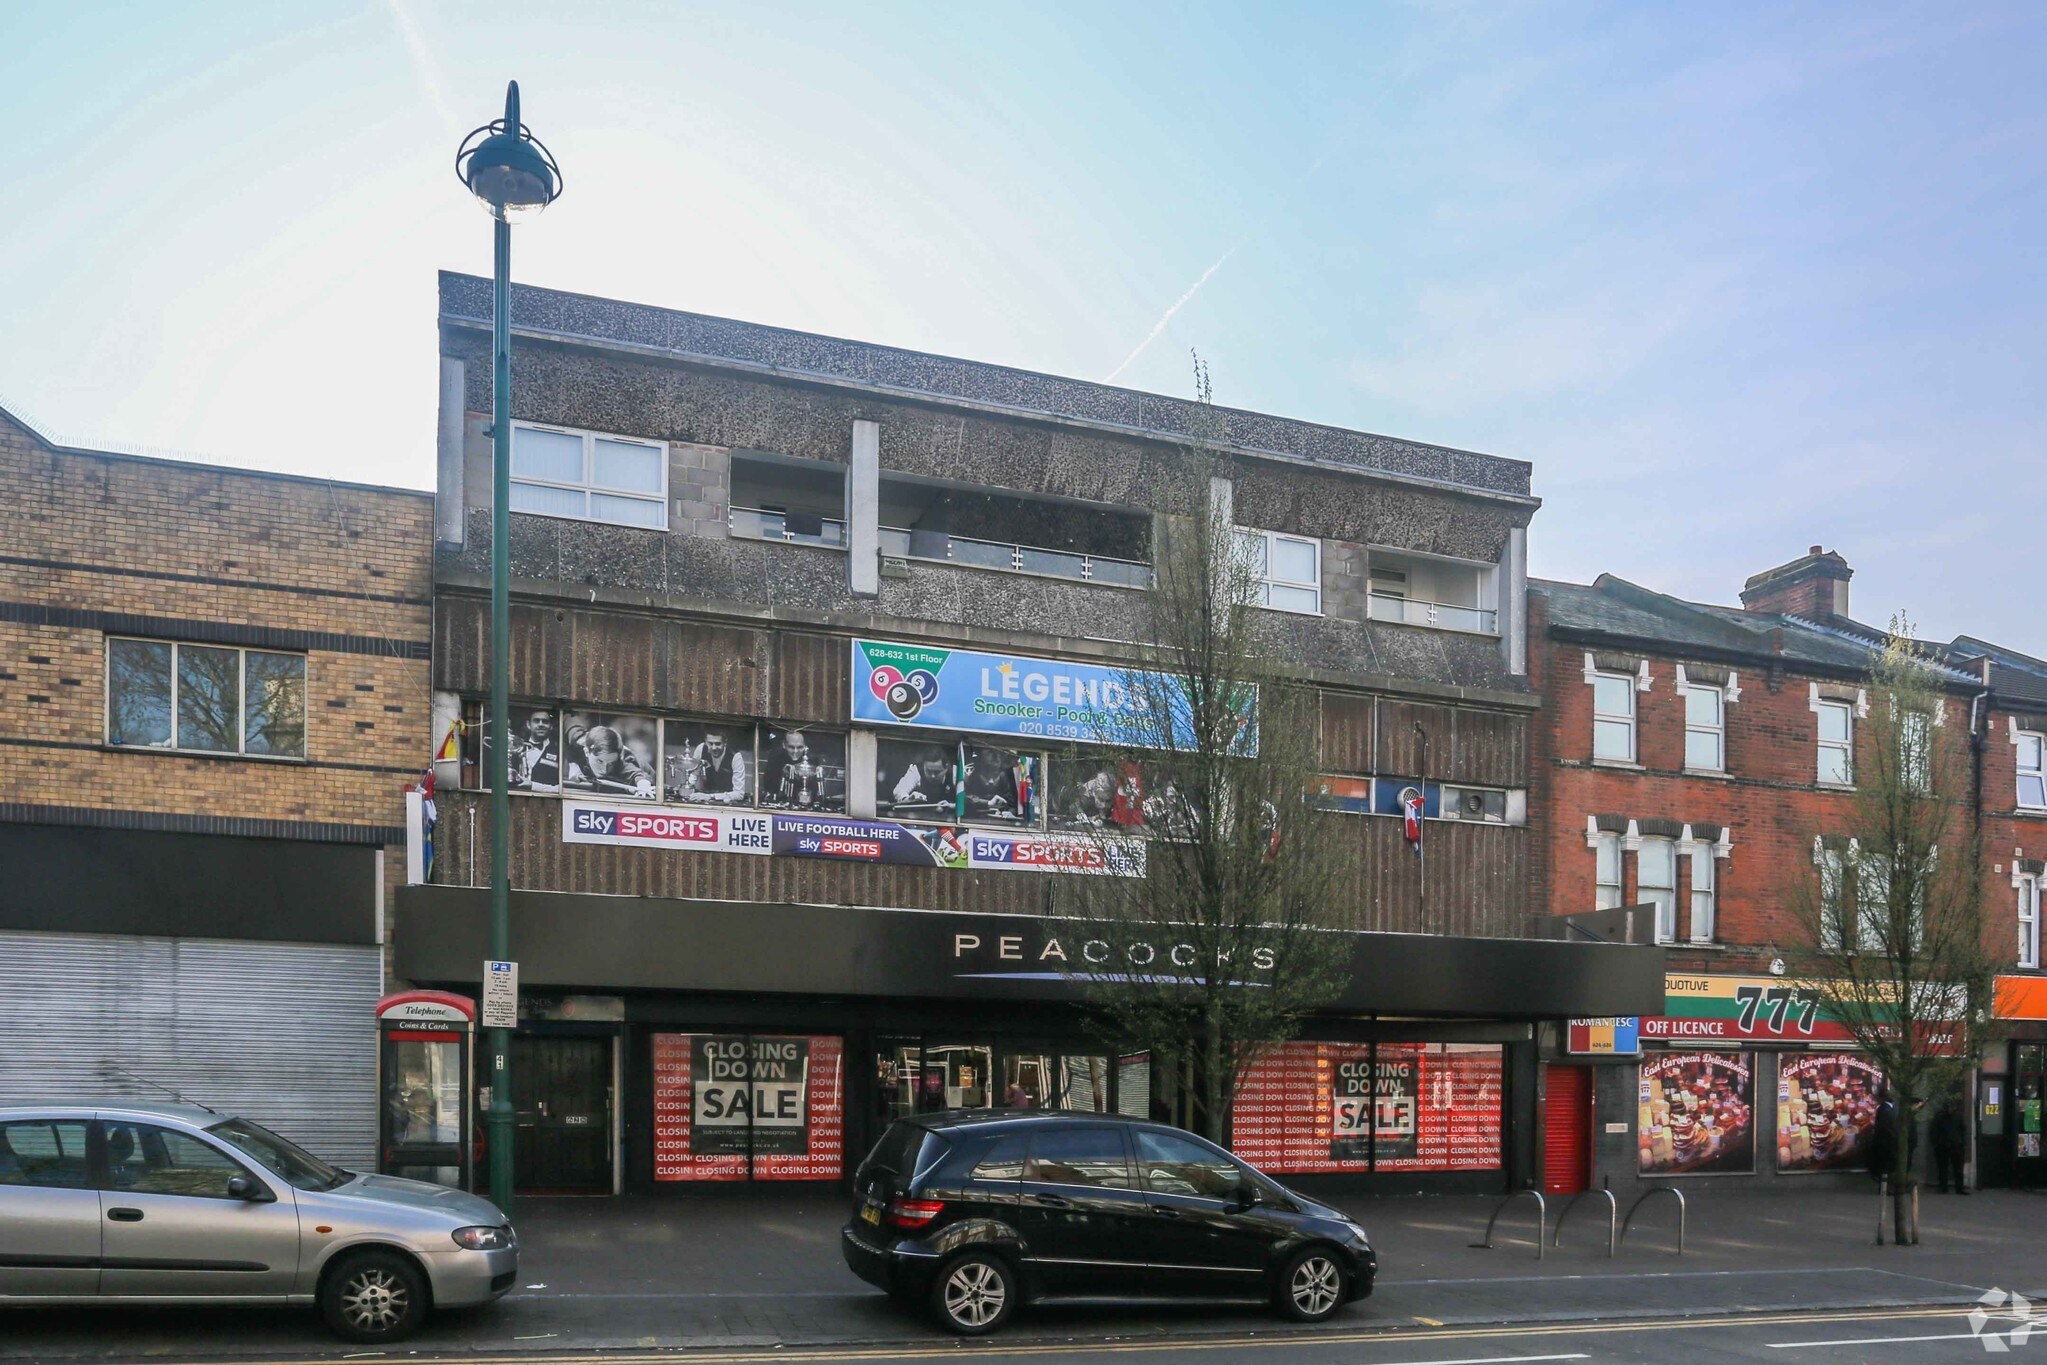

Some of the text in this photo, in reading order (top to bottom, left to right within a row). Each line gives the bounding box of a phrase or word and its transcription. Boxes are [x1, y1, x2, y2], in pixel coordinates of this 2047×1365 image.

[869, 648, 943, 664] 628-632 1st Floor
[896, 689, 904, 699] 7
[981, 667, 1150, 712] LEGENDS
[973, 698, 1043, 719] Snooker
[1056, 706, 1092, 725] Pool
[1098, 711, 1109, 726] &
[1019, 721, 1043, 735] 020
[1046, 724, 1078, 738] 8539
[577, 812, 715, 840] sky SPORTS
[731, 817, 767, 833] LIVE
[778, 820, 900, 840] LIVE FOOTBALL HERE
[728, 832, 770, 849] HERE
[798, 836, 879, 856] sky SPORTS
[976, 839, 1010, 863] sky
[1016, 842, 1103, 866] SPORTS
[955, 934, 1275, 970] PEACOCKS
[492, 963, 499, 971] P
[405, 1006, 447, 1016] Telephone
[1735, 984, 1821, 1035] 777
[399, 1021, 449, 1031] Coins & Cards
[1645, 1020, 1724, 1035] OFF LICENCE
[703, 1042, 797, 1060] CLOSING
[715, 1061, 786, 1078] DOWN
[1340, 1062, 1409, 1078] CLOSING
[1644, 1053, 1750, 1078] East European Delicatessen
[1783, 1055, 1883, 1078] East European Delicatessen
[812, 1078, 841, 1086] DOWN
[1347, 1079, 1401, 1094] DOWN
[656, 1089, 690, 1097] CLOSIN
[656, 1102, 690, 1110] CLOSIN
[703, 1088, 797, 1119] SALE
[1985, 1104, 1999, 1115] 622
[656, 1115, 690, 1123] CLOSIN
[1340, 1101, 1410, 1130] SALE
[812, 1141, 841, 1149] DOWN
[770, 1166, 810, 1174] CLOSING
[812, 1166, 840, 1174] DOWN
